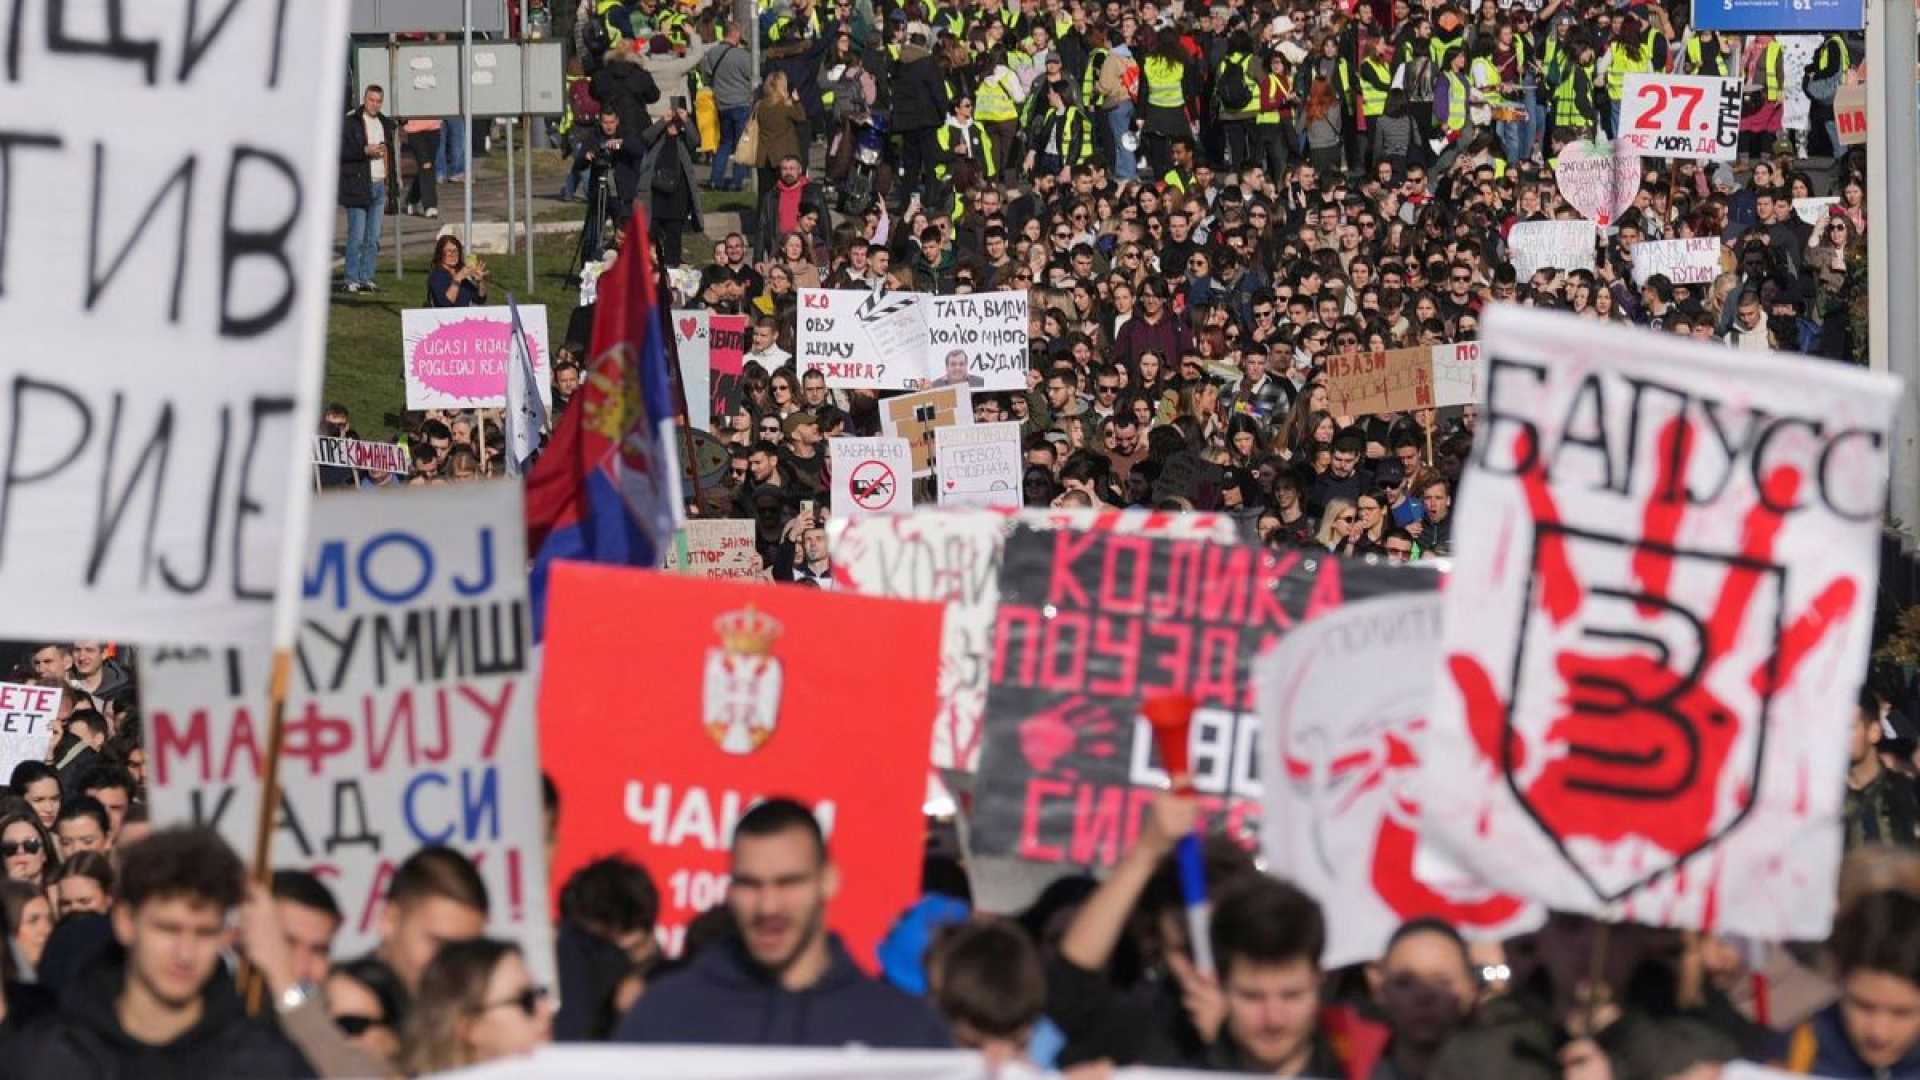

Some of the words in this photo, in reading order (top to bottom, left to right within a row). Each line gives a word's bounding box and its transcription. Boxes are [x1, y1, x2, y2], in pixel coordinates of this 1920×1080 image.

[1635, 83, 1710, 131] 27.
[1655, 136, 1692, 152] МОРА
[804, 294, 830, 309] КО
[806, 318, 834, 332] ОВУ
[423, 338, 467, 354] UGASI
[418, 360, 475, 377] POGLEDAJ
[1050, 529, 1345, 630] КОЛИКА
[151, 681, 516, 788] МАФИЈУ
[403, 766, 502, 848] СИ
